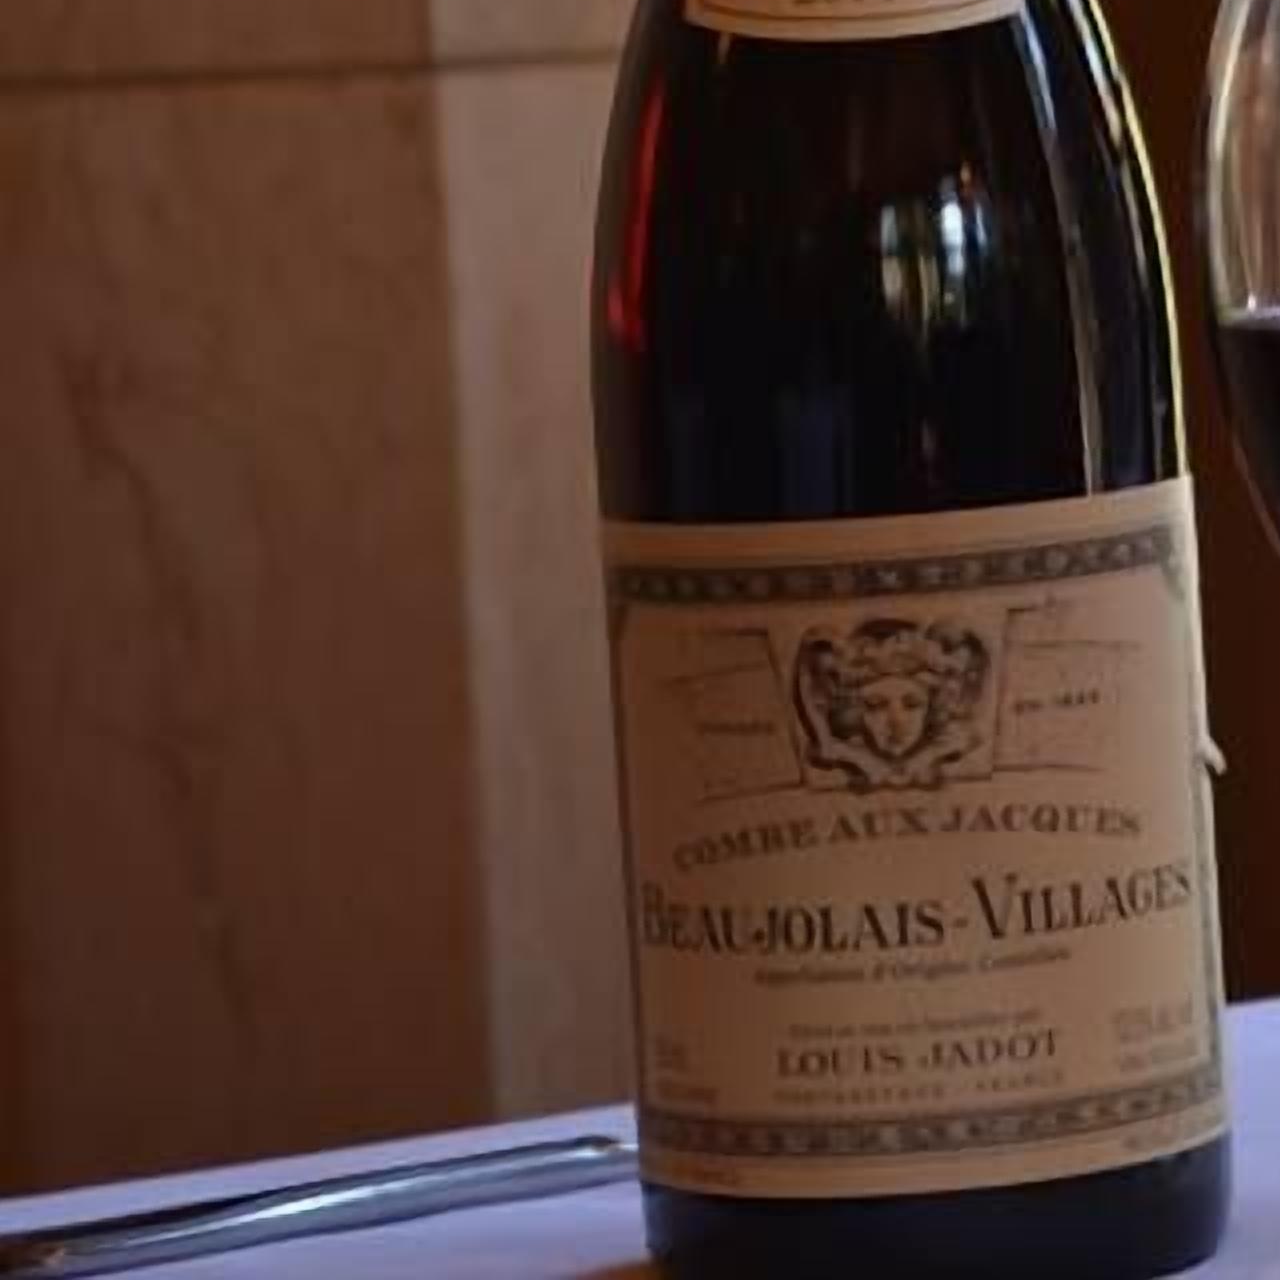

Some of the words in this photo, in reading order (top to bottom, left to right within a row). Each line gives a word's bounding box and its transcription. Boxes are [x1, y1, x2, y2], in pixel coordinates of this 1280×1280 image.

[828, 807, 930, 842] AUX
[938, 803, 1141, 838] JACQUES
[777, 1041, 904, 1077] LOUIS
[918, 1028, 1056, 1067] JADOT
